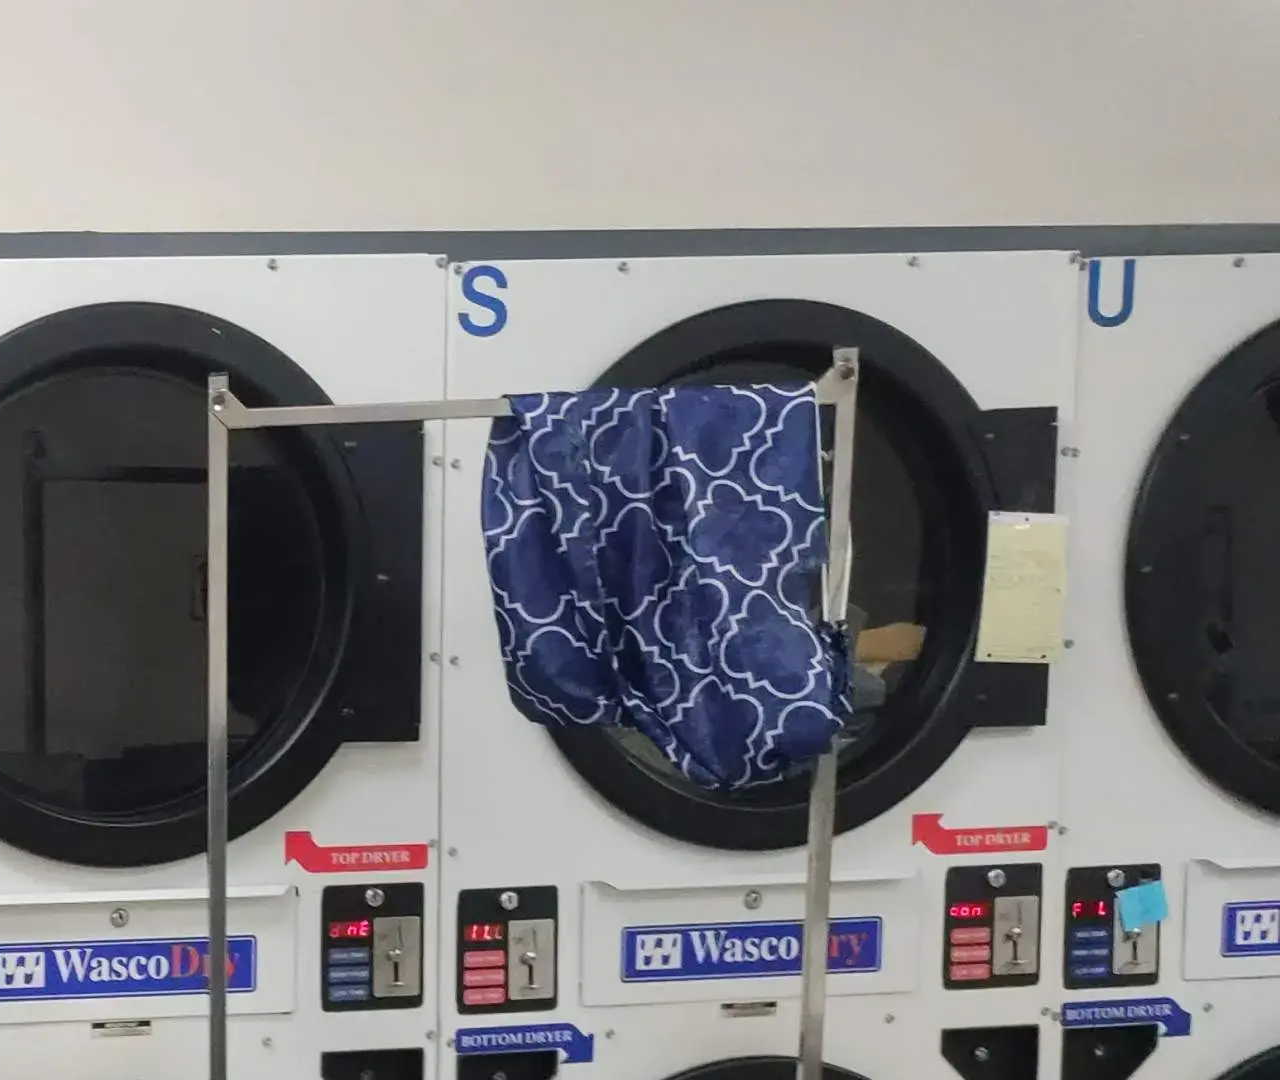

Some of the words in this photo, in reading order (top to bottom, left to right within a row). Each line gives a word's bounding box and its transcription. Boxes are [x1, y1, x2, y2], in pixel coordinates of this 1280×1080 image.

[457, 265, 508, 337] S
[1087, 259, 1137, 327] U
[330, 853, 360, 865] TOP
[362, 851, 411, 863] DRYER
[688, 930, 869, 966] Wascory
[1066, 1007, 1126, 1021] BOTTOM
[461, 1034, 525, 1047] BOTTOM
[526, 1030, 573, 1044] DRYER
